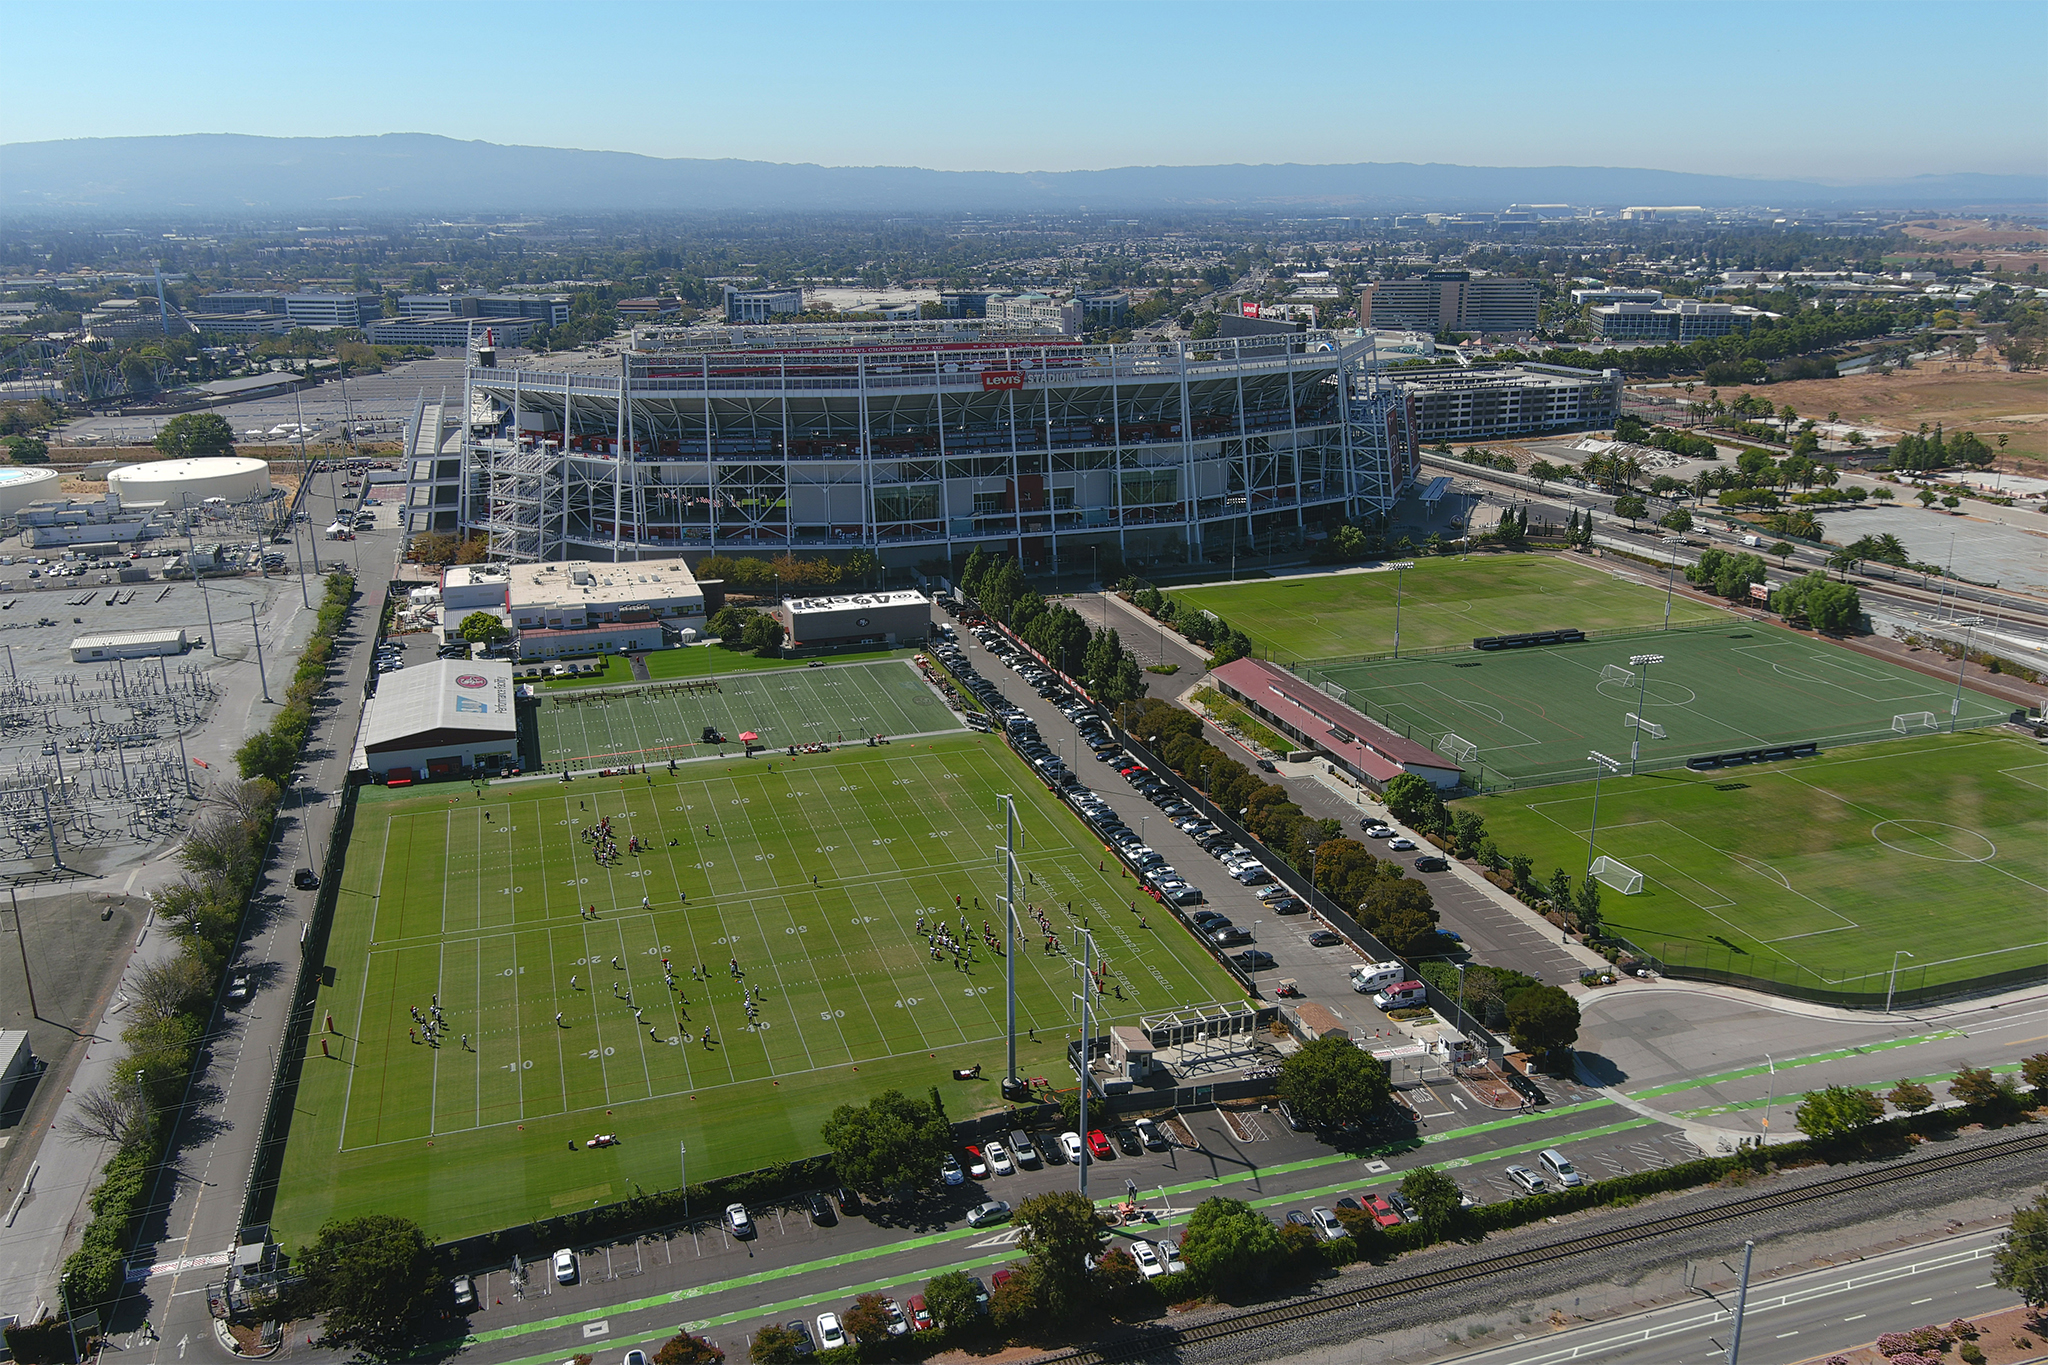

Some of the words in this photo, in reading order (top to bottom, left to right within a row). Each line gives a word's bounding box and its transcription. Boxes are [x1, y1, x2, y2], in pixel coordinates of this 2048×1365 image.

[1027, 372, 1077, 384] STADIUM
[754, 853, 775, 861] 50
[785, 925, 808, 935] 50
[820, 1009, 846, 1021] 50
[1409, 1087, 1433, 1103] STOP
